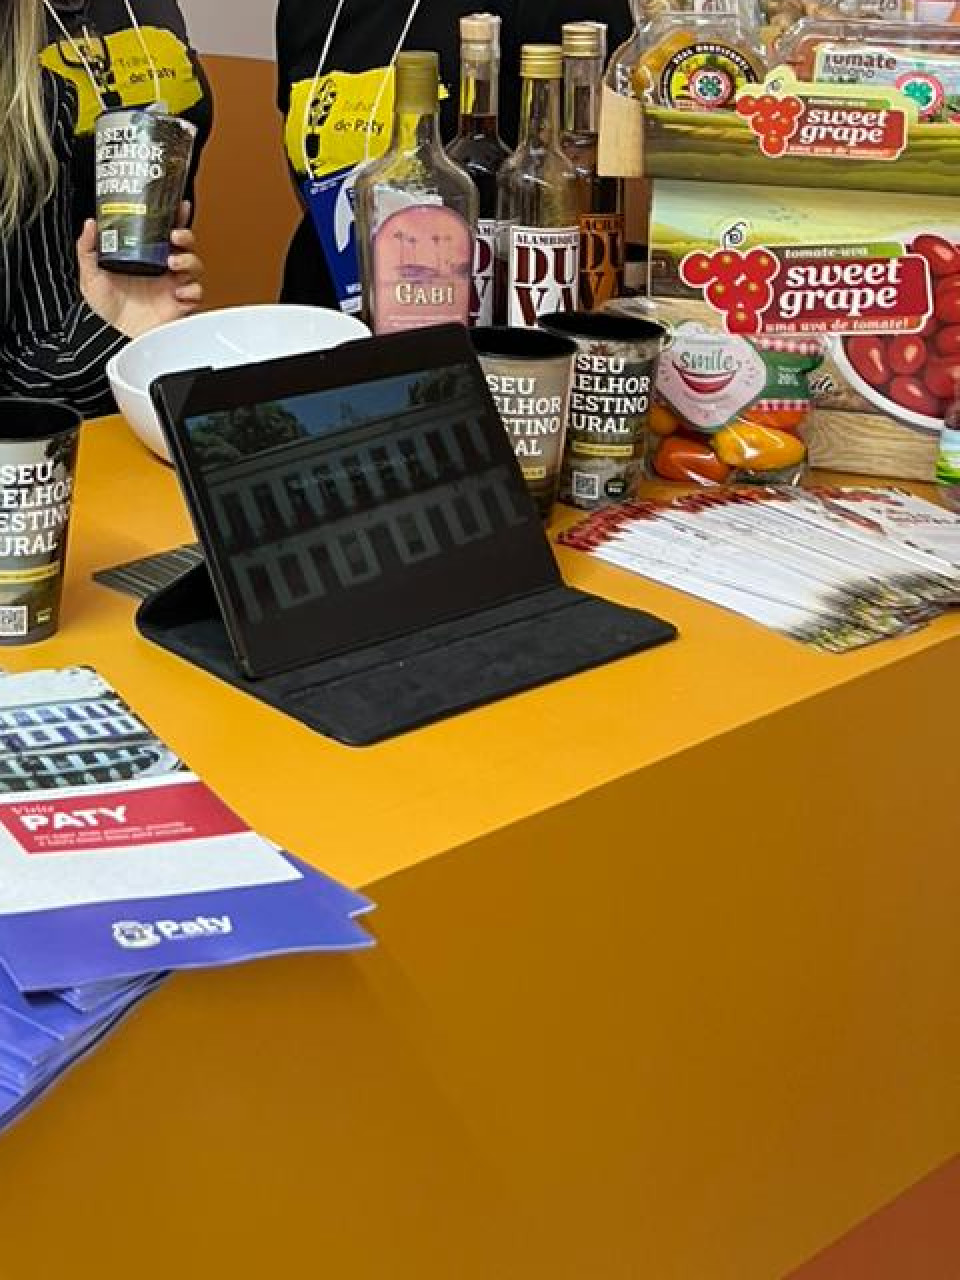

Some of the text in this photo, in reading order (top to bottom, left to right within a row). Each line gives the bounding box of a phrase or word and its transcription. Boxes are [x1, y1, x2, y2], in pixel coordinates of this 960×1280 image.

[333, 119, 352, 133] de
[808, 109, 888, 127] sweet
[800, 125, 884, 146] grape
[785, 246, 868, 260] tomate-uva
[515, 246, 578, 285] DU
[786, 258, 903, 287] sweet
[779, 286, 897, 318] grape
[577, 354, 625, 374] SEU
[485, 373, 537, 395] SEU
[576, 373, 651, 395] ELHOR
[572, 393, 649, 414] ESTINO
[0, 460, 54, 485] SEU
[20, 805, 128, 832] PATY
[156, 915, 233, 942] Paty
